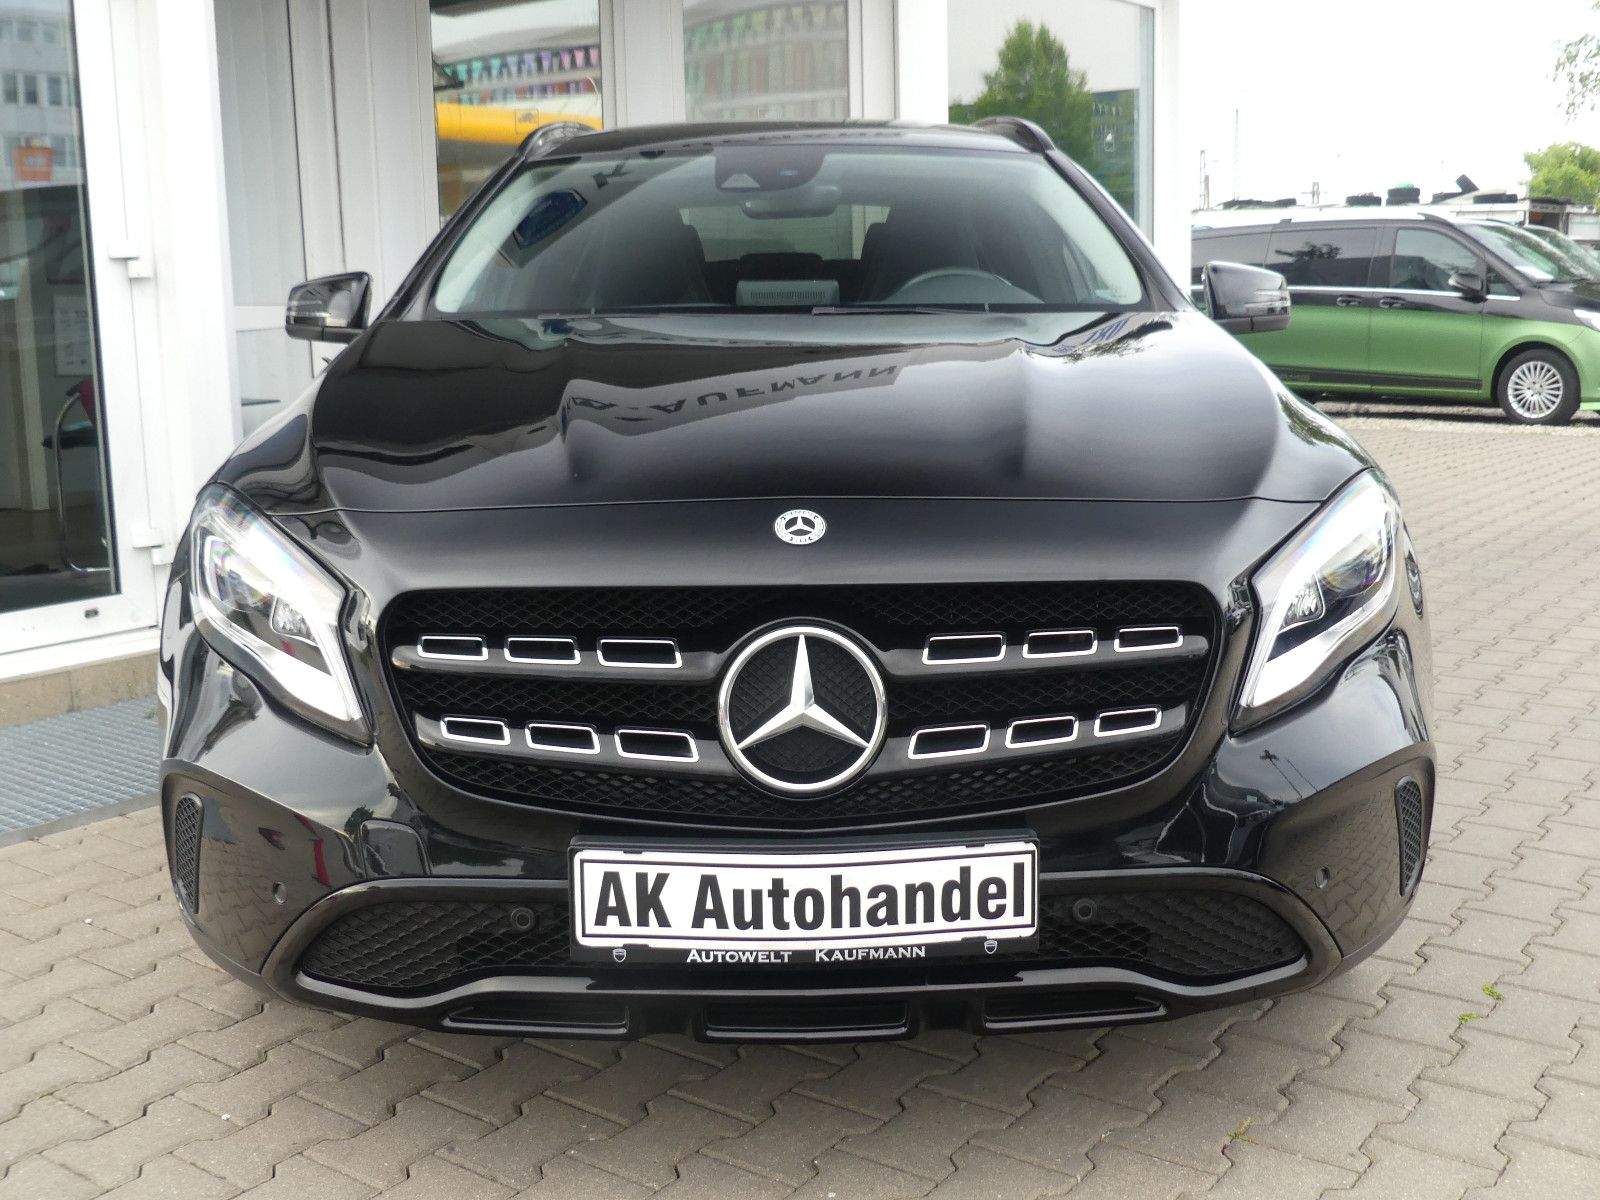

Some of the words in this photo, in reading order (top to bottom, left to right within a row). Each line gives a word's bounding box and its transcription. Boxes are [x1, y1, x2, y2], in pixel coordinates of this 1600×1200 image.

[594, 870, 671, 927] AK
[691, 861, 1025, 930] Autohandel
[686, 949, 792, 963] AUTOWELT
[815, 945, 927, 962] KAUFMANN
